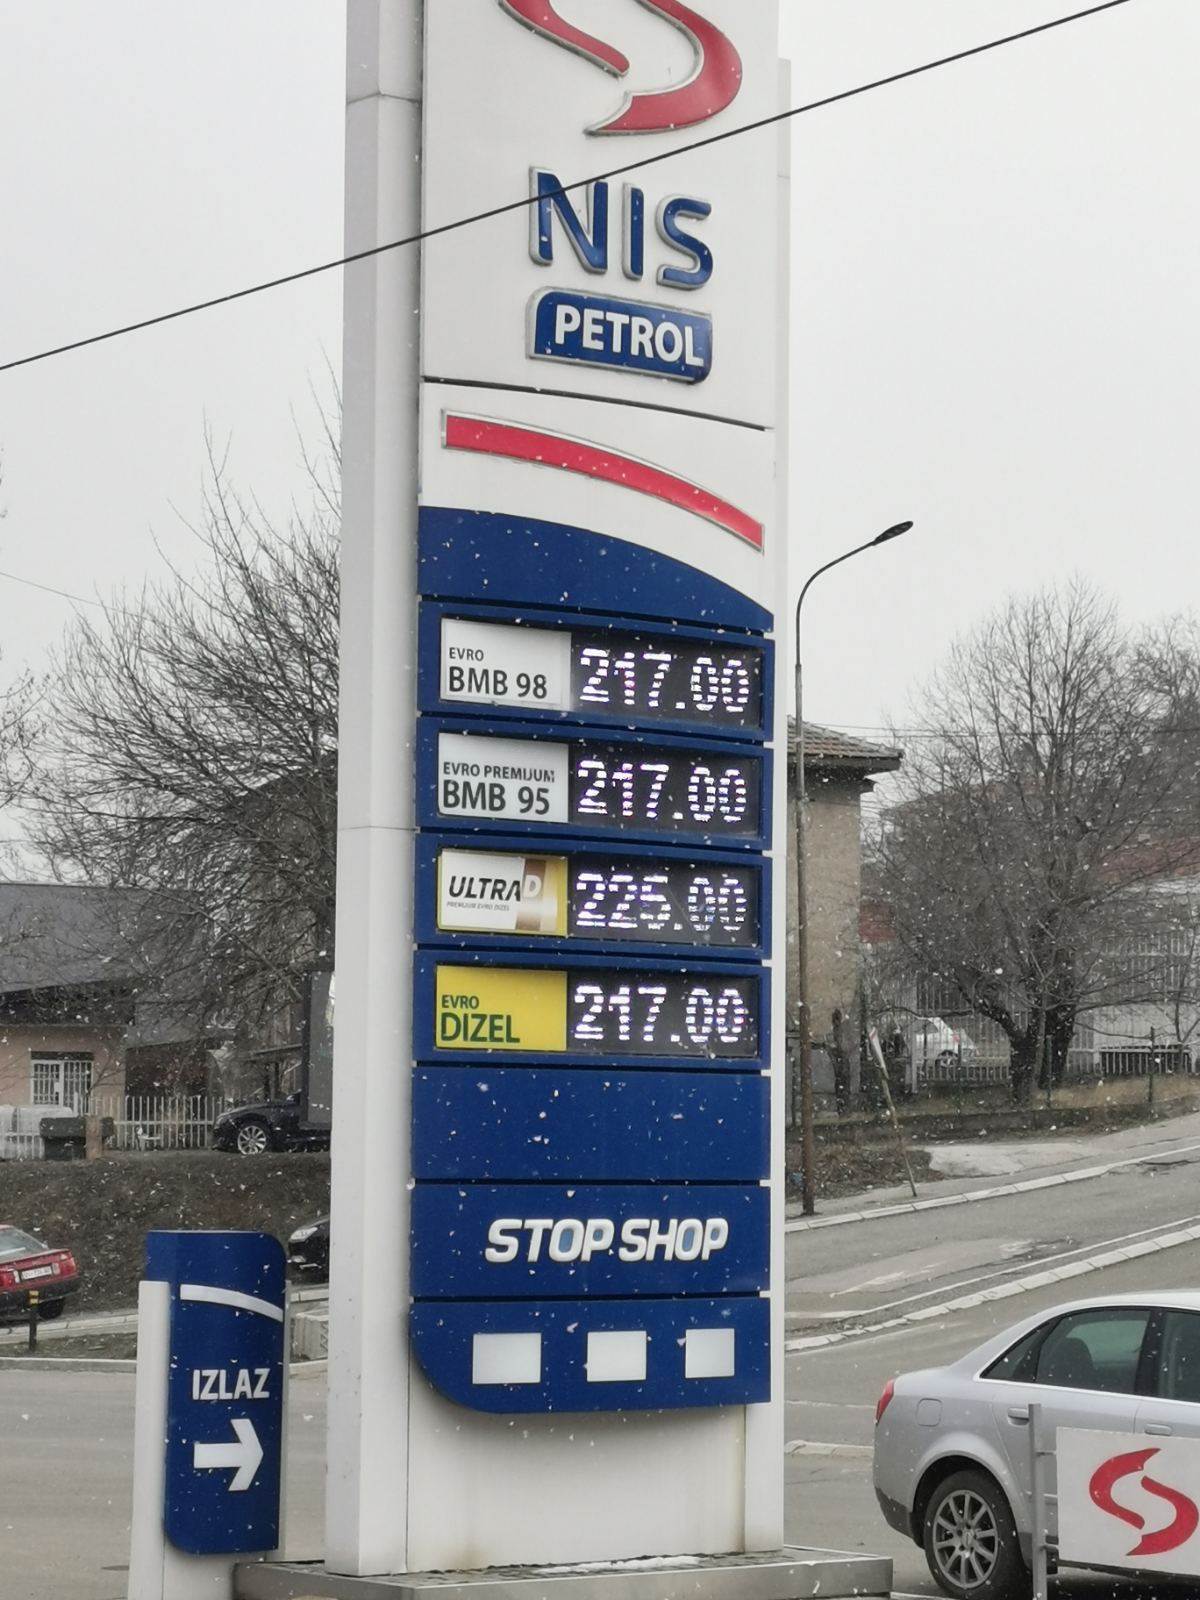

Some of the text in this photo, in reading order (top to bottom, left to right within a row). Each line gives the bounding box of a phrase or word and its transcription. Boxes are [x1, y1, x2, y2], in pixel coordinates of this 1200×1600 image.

[530, 167, 713, 290] NIS
[555, 304, 704, 367] PETROL
[449, 647, 484, 661] EVRO
[449, 666, 547, 699] BMB 98
[580, 647, 749, 712] 217.00
[443, 761, 480, 777] EVRO
[443, 779, 550, 815] BMB 95
[577, 760, 746, 822] 217.00
[576, 873, 747, 931] 225.00
[441, 994, 480, 1010] EVRO
[574, 985, 744, 1043] 217.00
[440, 1012, 521, 1043] DIZEL
[485, 1217, 729, 1263] STOP SHOP
[192, 1367, 271, 1401] IZLAZ
